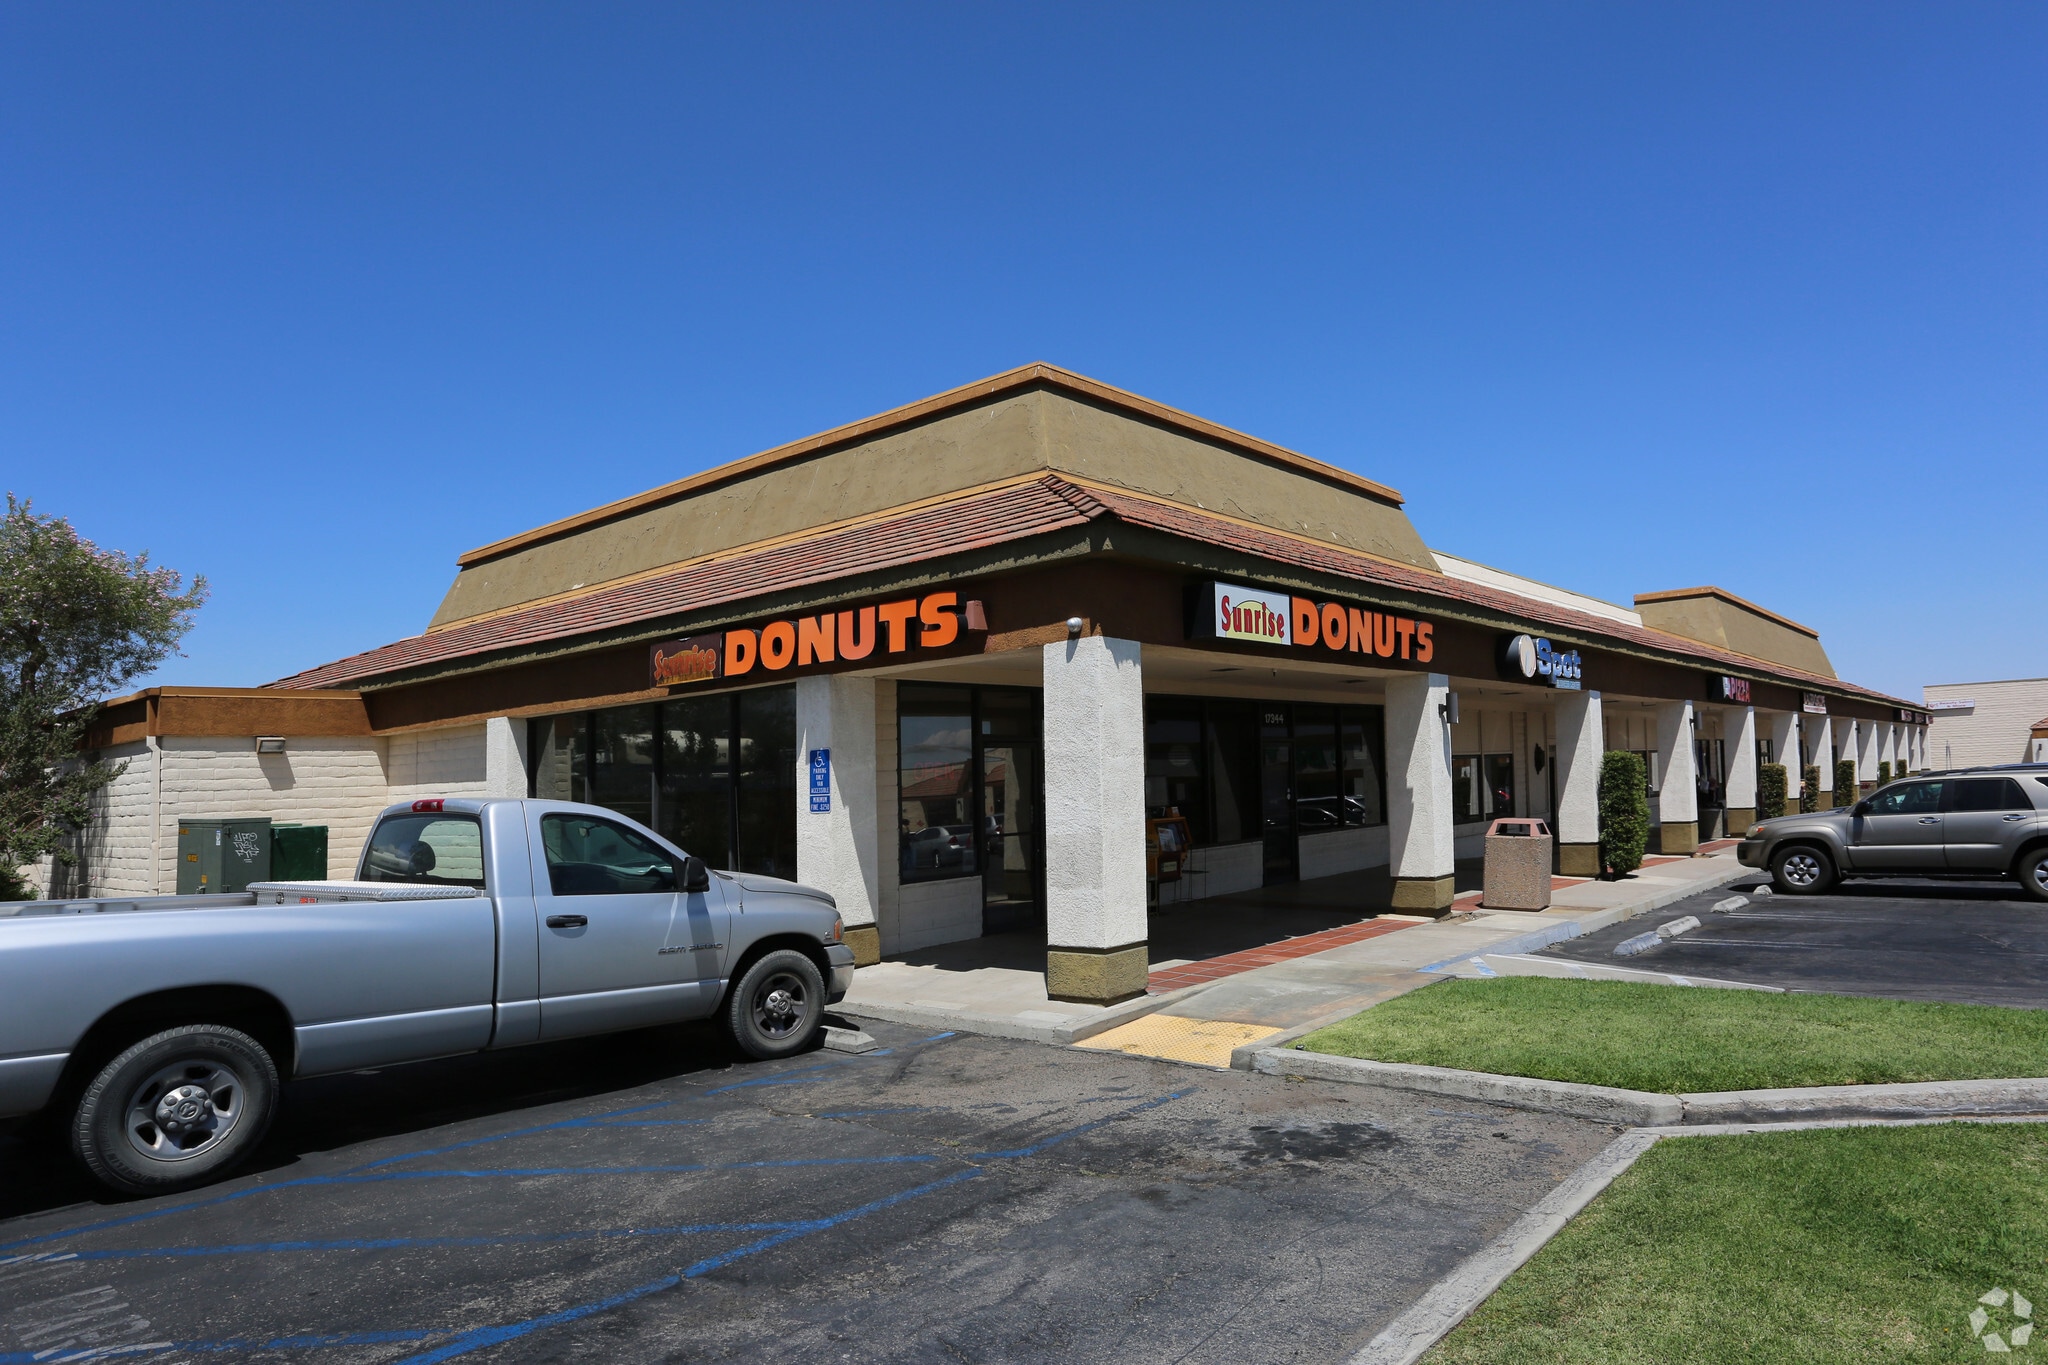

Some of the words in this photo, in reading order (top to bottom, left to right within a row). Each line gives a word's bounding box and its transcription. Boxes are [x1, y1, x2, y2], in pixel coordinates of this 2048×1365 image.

[654, 644, 716, 680] Sunrise
[724, 591, 958, 676] DONUTS
[1220, 595, 1285, 638] Sunrise
[1292, 596, 1433, 663] DONUTS
[1536, 637, 1582, 684] Spot
[1730, 676, 1751, 702] PIZZA
[1264, 713, 1284, 725] 17344
[913, 761, 957, 782] OPEN
